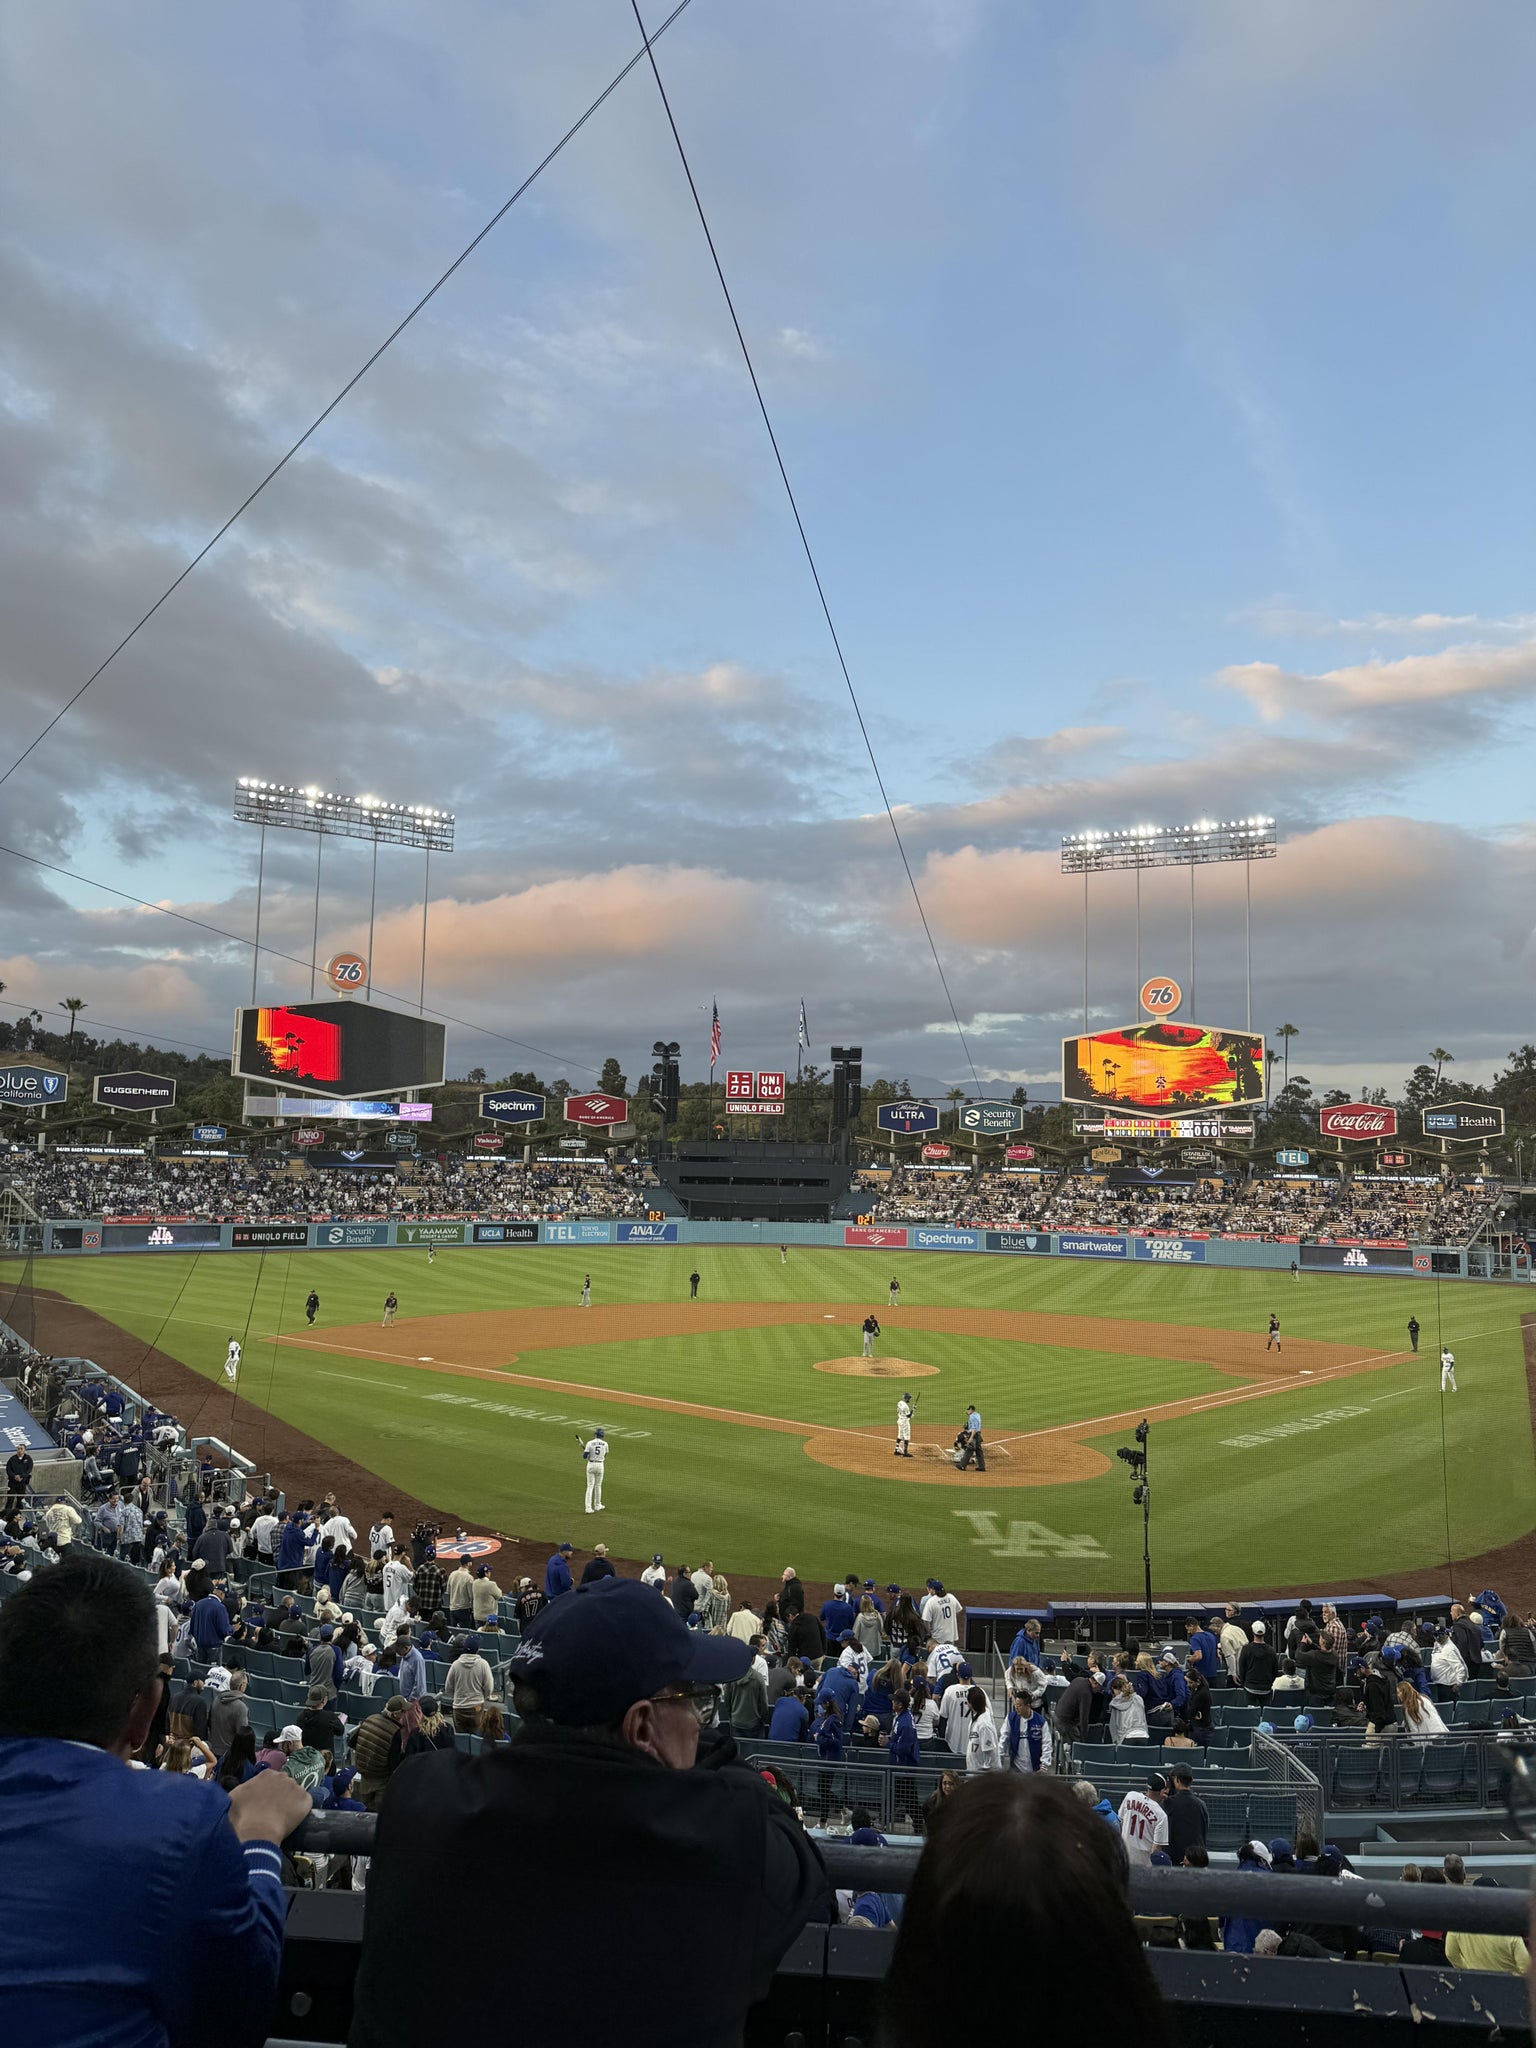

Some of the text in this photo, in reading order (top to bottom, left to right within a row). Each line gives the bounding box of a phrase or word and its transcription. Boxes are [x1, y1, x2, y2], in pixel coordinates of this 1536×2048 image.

[335, 963, 362, 982] 76
[1148, 985, 1174, 1006] 76
[103, 1086, 169, 1096] GUGGENHEIM
[489, 1099, 535, 1112] Spectrum
[729, 1104, 781, 1113] UNIQLO FIELD
[890, 1110, 926, 1120] ULTRA
[983, 1109, 1016, 1119] Security
[983, 1118, 1012, 1128] Benefit
[1427, 1116, 1497, 1128] UCLA Health
[297, 1130, 320, 1141] JINRO
[923, 1146, 949, 1156] Churu
[1279, 1152, 1306, 1164] TEL
[346, 1226, 377, 1236] Security
[481, 1228, 533, 1238] UCLA Health
[547, 1226, 576, 1240] TEL
[629, 1225, 654, 1236] ANA
[85, 1234, 98, 1244] 76
[251, 1232, 280, 1242] UNIQLO
[282, 1232, 306, 1240] FIELD
[346, 1235, 373, 1243] Benefit
[918, 1232, 970, 1246] Spectrum
[1000, 1235, 1026, 1246] blue
[1062, 1241, 1124, 1253] smartwater
[1144, 1240, 1184, 1250] TOYO
[1150, 1249, 1193, 1261] TIRES
[1415, 1257, 1429, 1268] 76
[594, 1446, 601, 1456] 5
[371, 1531, 381, 1544] 50
[952, 1510, 1113, 1559] LA
[436, 1540, 494, 1554] 76
[386, 1574, 392, 1588] 5
[524, 1599, 539, 1618] 17
[941, 1605, 952, 1620] 10
[939, 1650, 960, 1669] 67
[956, 1690, 968, 1699] OHT
[971, 1743, 979, 1753] 17
[1127, 1799, 1158, 1825] RAMÍREZ
[1130, 1813, 1145, 1840] 11
